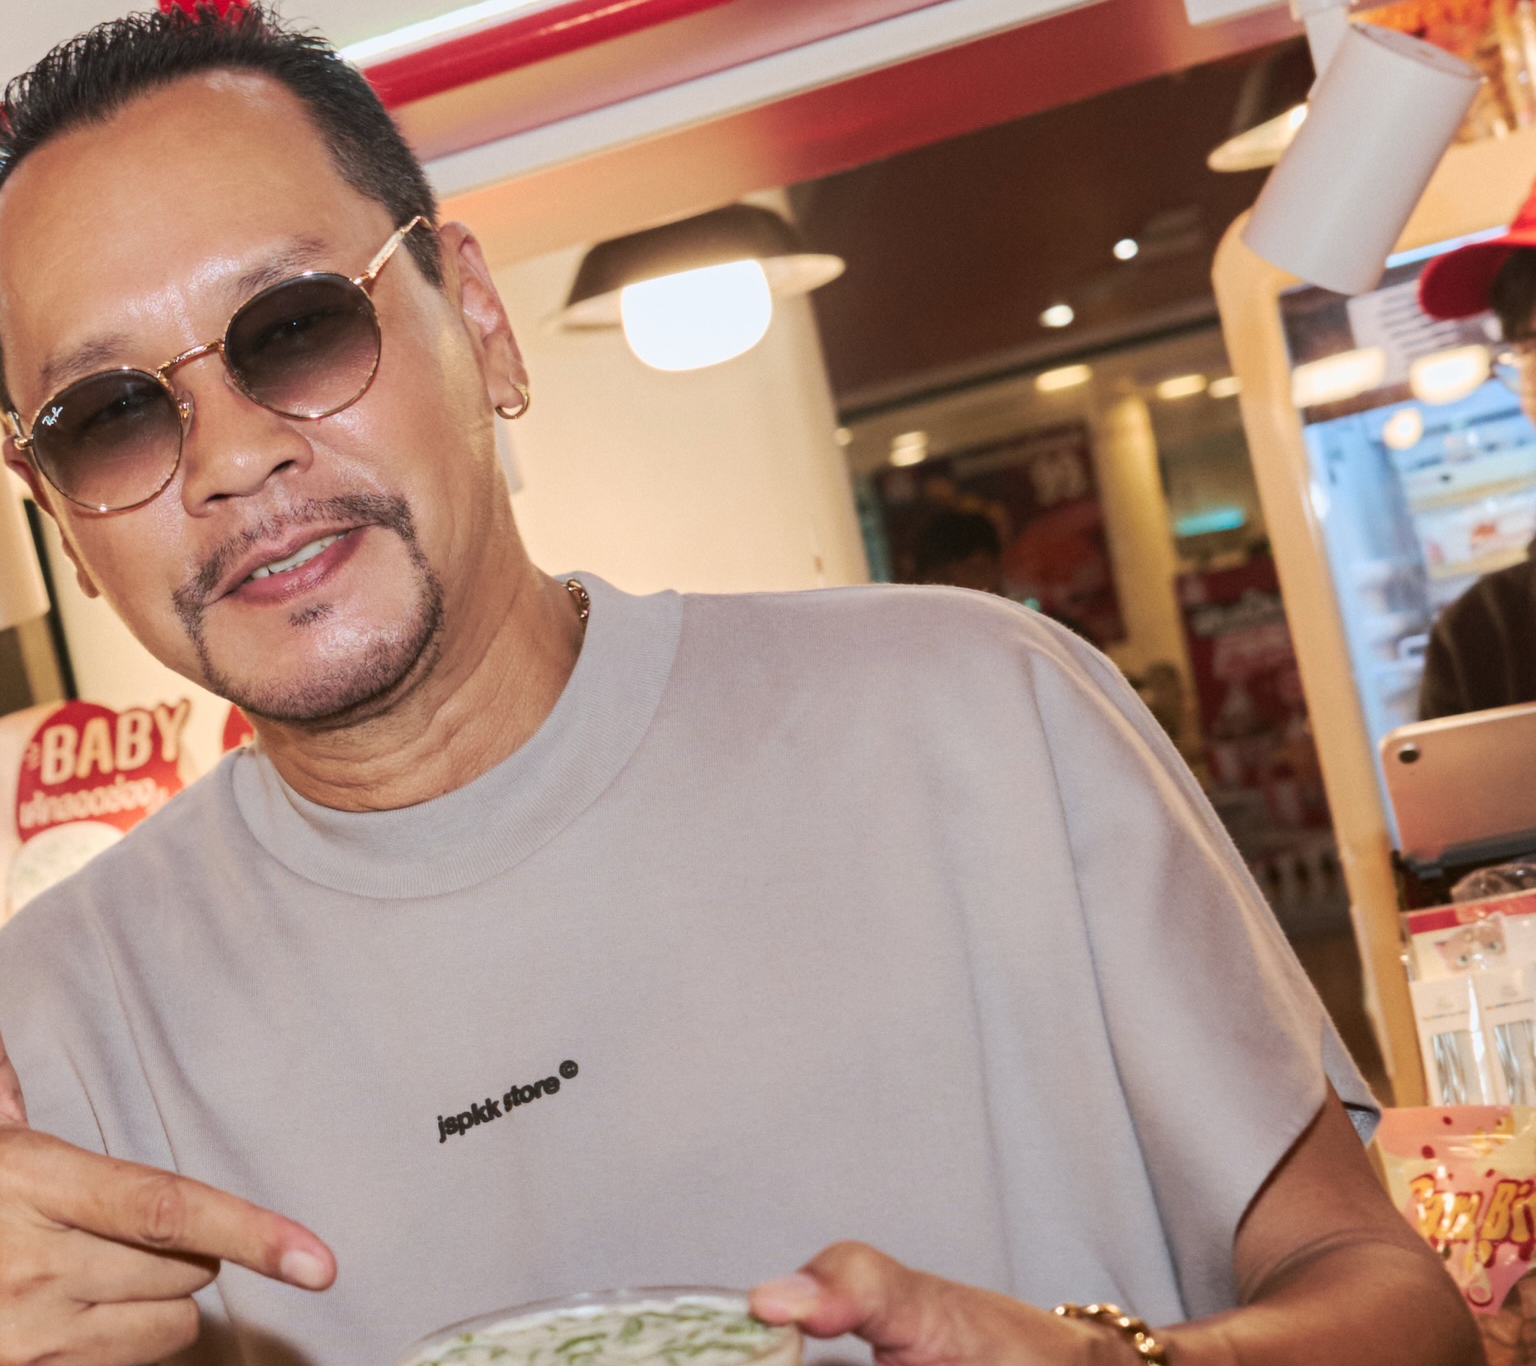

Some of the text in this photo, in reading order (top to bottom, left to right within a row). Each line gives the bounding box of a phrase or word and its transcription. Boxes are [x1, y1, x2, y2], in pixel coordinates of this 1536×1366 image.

[40, 698, 192, 786] BABY
[437, 1076, 561, 1144] jspkk store
